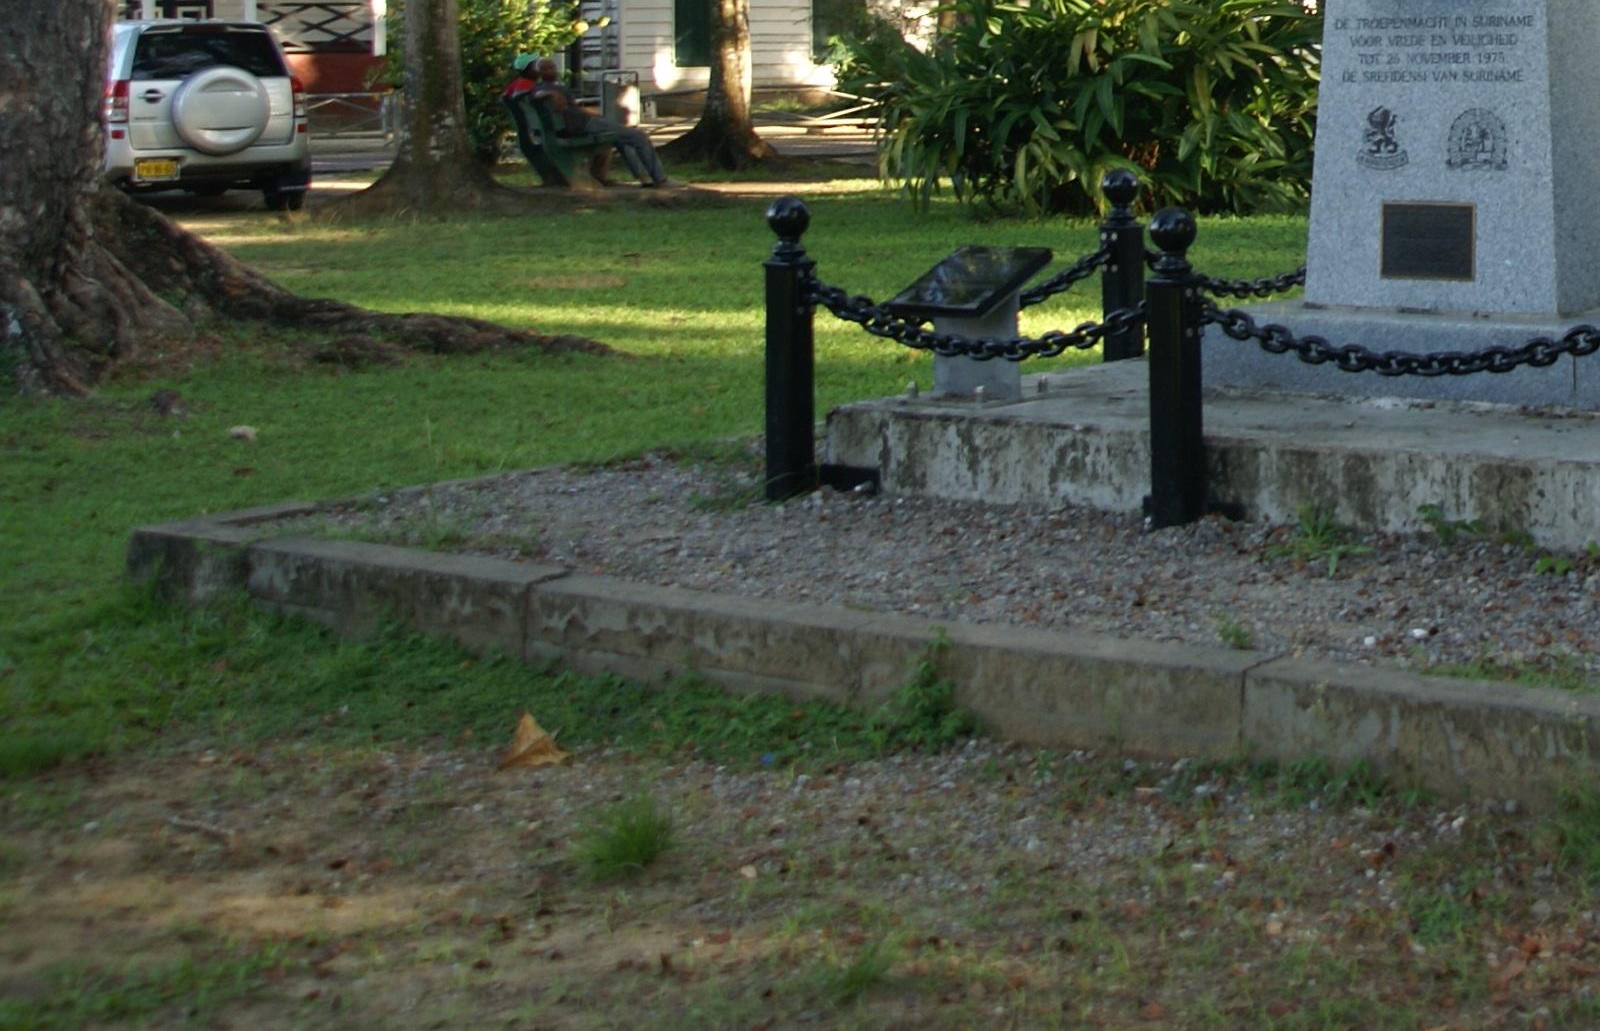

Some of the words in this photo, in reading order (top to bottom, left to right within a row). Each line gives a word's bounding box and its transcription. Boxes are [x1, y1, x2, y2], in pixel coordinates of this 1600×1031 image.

[1335, 17, 1349, 30] DE
[1356, 16, 1449, 30] TROEPENMACHT
[1455, 16, 1468, 28] IN
[1472, 15, 1535, 28] SURINAME
[1350, 35, 1383, 47] VOOR
[1388, 35, 1425, 47] VREDE
[1431, 35, 1447, 47] EN
[1357, 53, 1381, 65] TOT
[1406, 52, 1471, 65] NOVEMBER
[1342, 71, 1357, 83] DE
[1432, 71, 1458, 83] VAN
[1462, 71, 1525, 83] SURINAME
